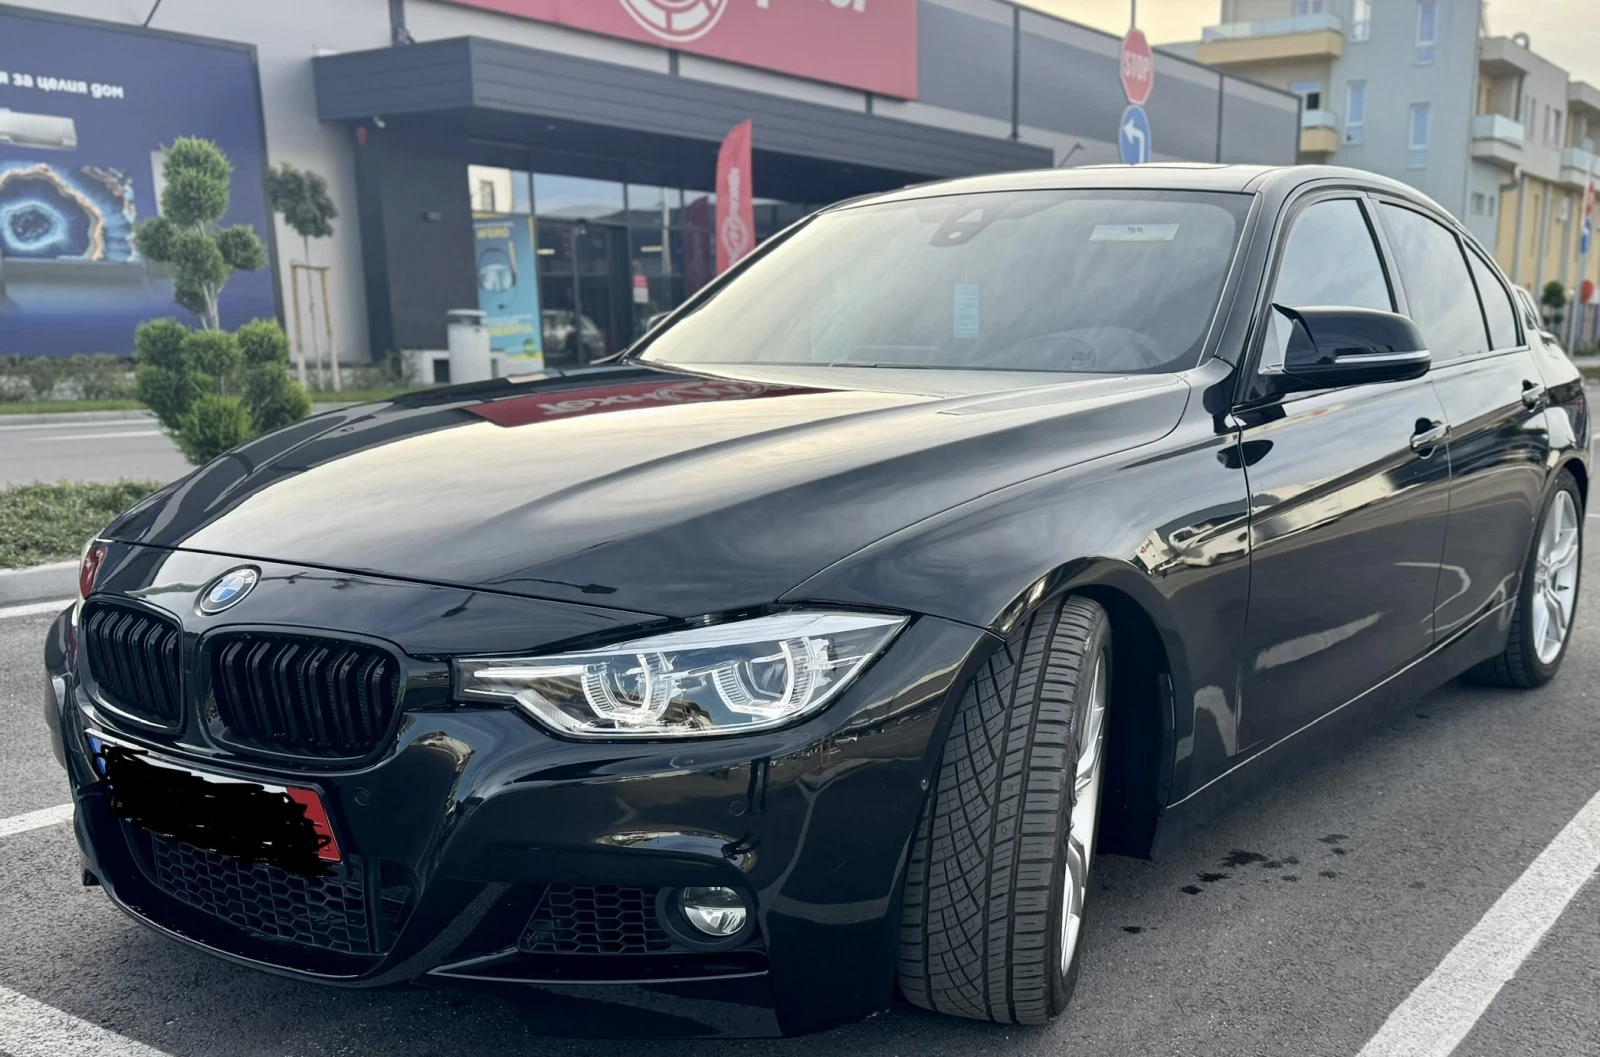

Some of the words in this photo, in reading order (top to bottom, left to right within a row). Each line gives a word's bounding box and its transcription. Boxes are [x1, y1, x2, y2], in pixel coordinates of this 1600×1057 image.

[1124, 51, 1149, 80] STOP
[12, 73, 33, 88] за
[37, 76, 88, 95] целия
[90, 83, 124, 99] дом
